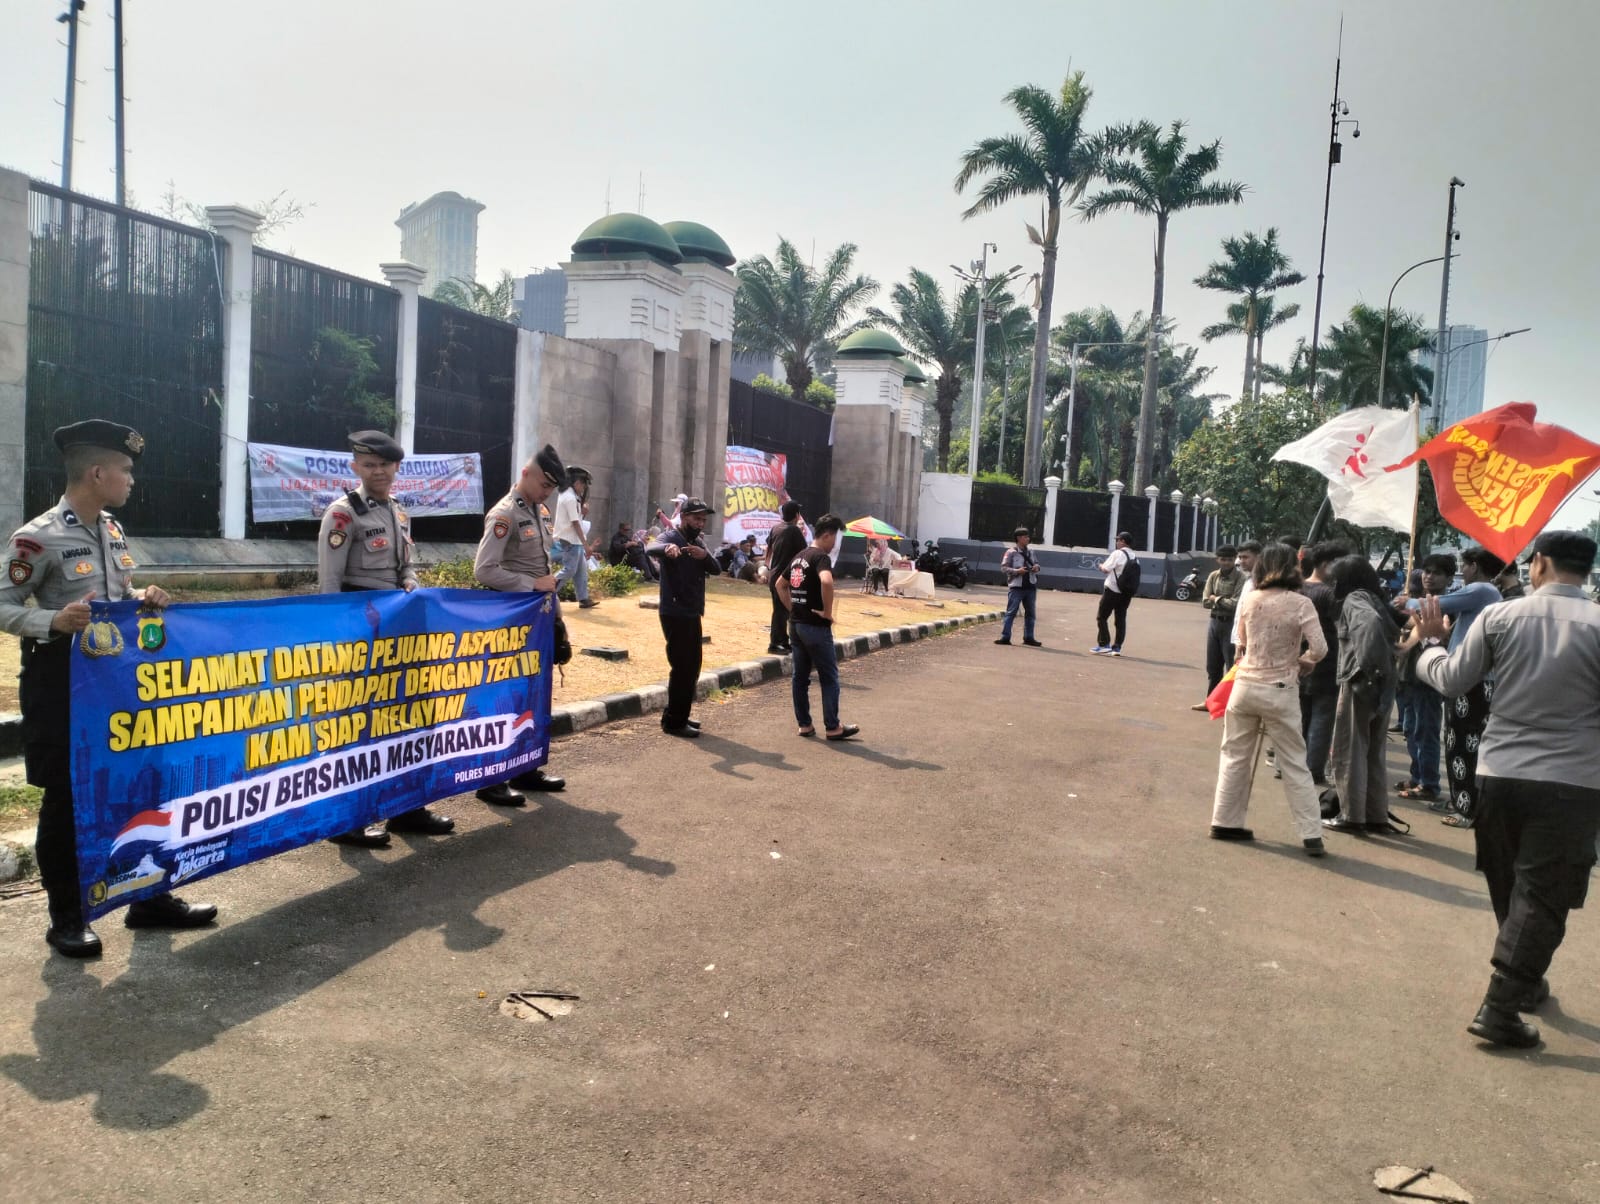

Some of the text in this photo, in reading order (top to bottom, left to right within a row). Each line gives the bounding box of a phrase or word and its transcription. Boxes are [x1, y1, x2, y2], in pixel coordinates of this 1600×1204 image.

[304, 456, 352, 475] POSK
[136, 648, 268, 702] SELAMAT
[273, 640, 368, 681] DATANG
[370, 632, 456, 668] PEJUANG
[109, 686, 293, 752] SAMPAIKAN
[297, 671, 404, 717] PENDAPAT
[404, 659, 484, 698] DENGAN
[314, 715, 368, 752] SIAP
[370, 693, 467, 738] MELAYANI
[181, 720, 507, 838] POLISI BERSAMA MASYARAKAT
[454, 747, 543, 784] POLRES METRO JAKARTA PUSAT
[170, 848, 226, 883] Jakarta
